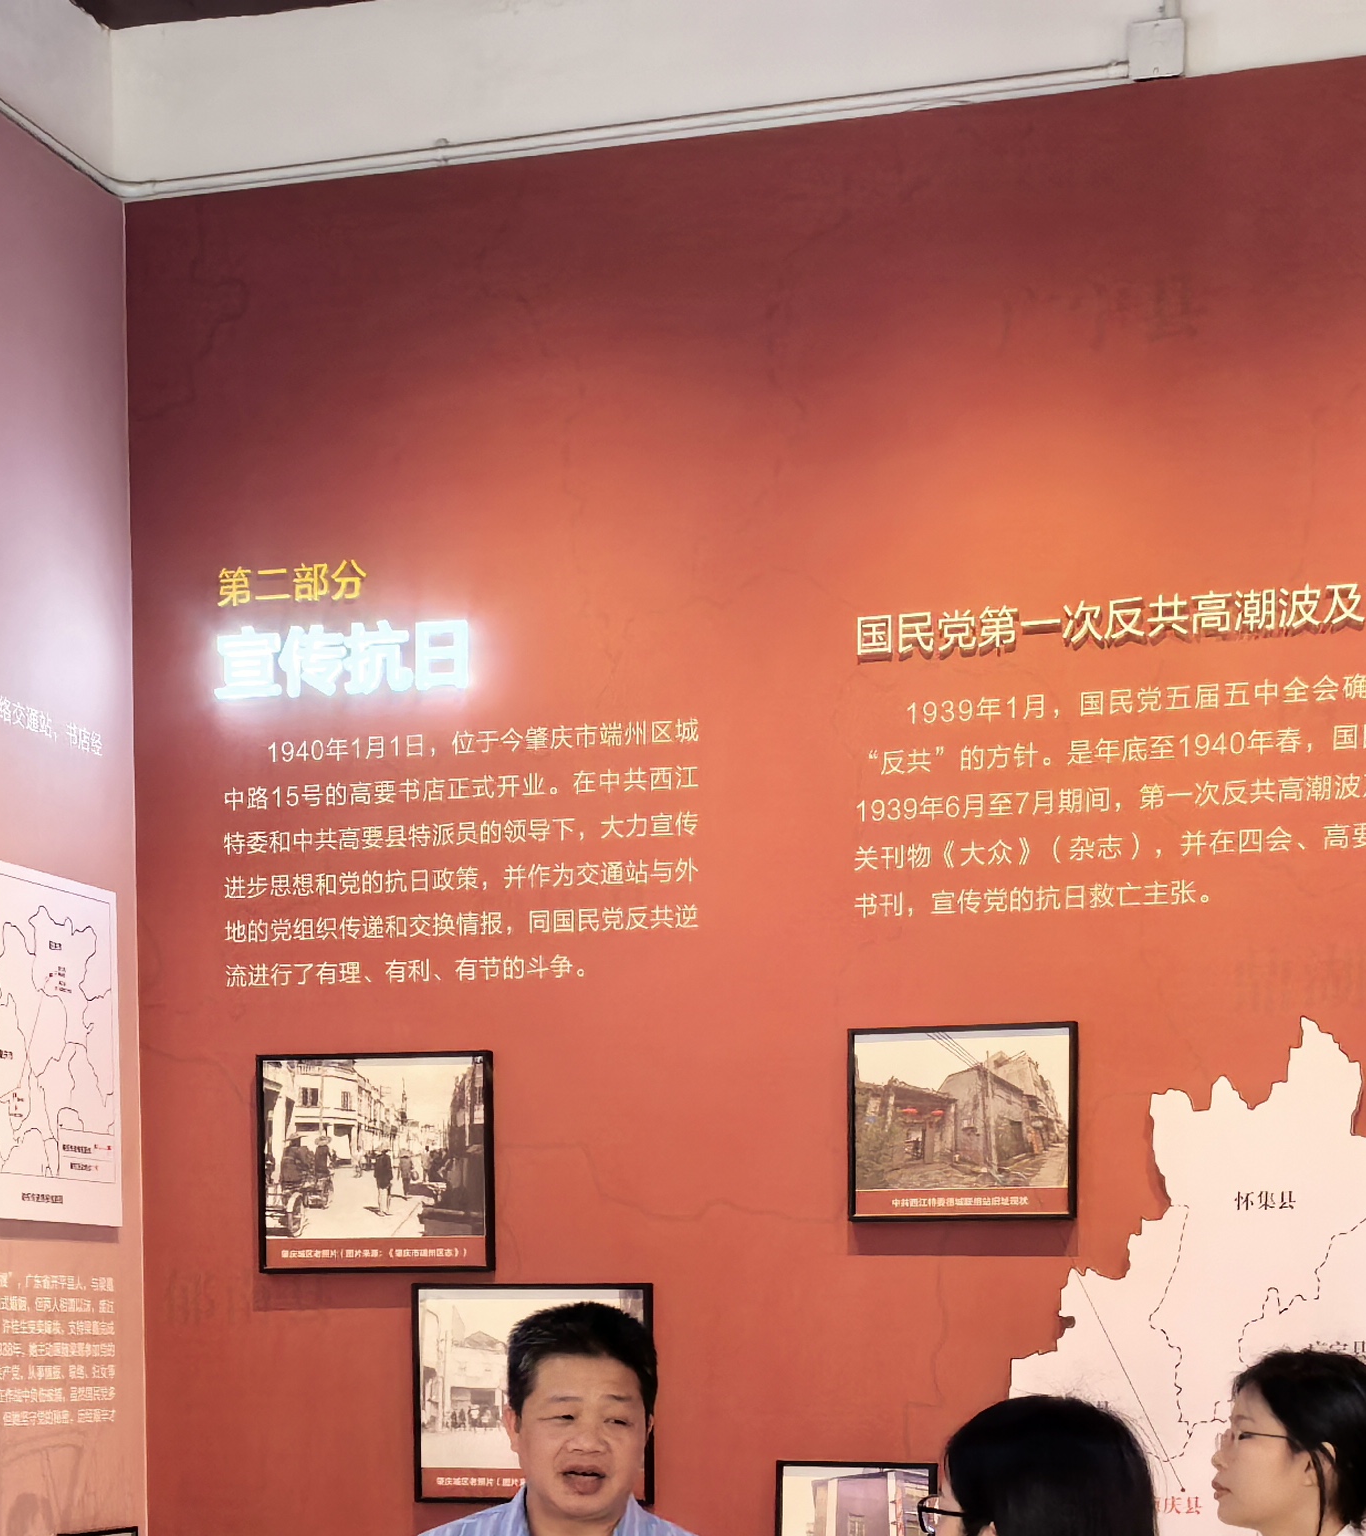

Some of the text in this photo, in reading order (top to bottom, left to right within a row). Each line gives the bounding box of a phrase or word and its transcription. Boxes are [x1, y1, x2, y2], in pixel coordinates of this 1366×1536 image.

[217, 559, 367, 607] 第二部分
[214, 619, 470, 701] 宣传抗日
[266, 718, 699, 765] 1940年1月1日，位于今肇庆市端州区城
[223, 764, 699, 812] 中路15号的高要书店正式开业。在中共西江
[223, 810, 699, 856] 特委和中共高要县特派员的领导下，大力宣传
[223, 857, 699, 900] 进步思想和党的抗日政策，并作为交通站与外
[854, 880, 1212, 918] 书刊，宣传党的抗日救亡主张。
[225, 904, 699, 945] 地的党组织传递和交换情报，同国民党反共逆
[225, 954, 587, 989] 流进行了有理、有利、有节的斗争。
[1234, 1190, 1297, 1211] 怀集县
